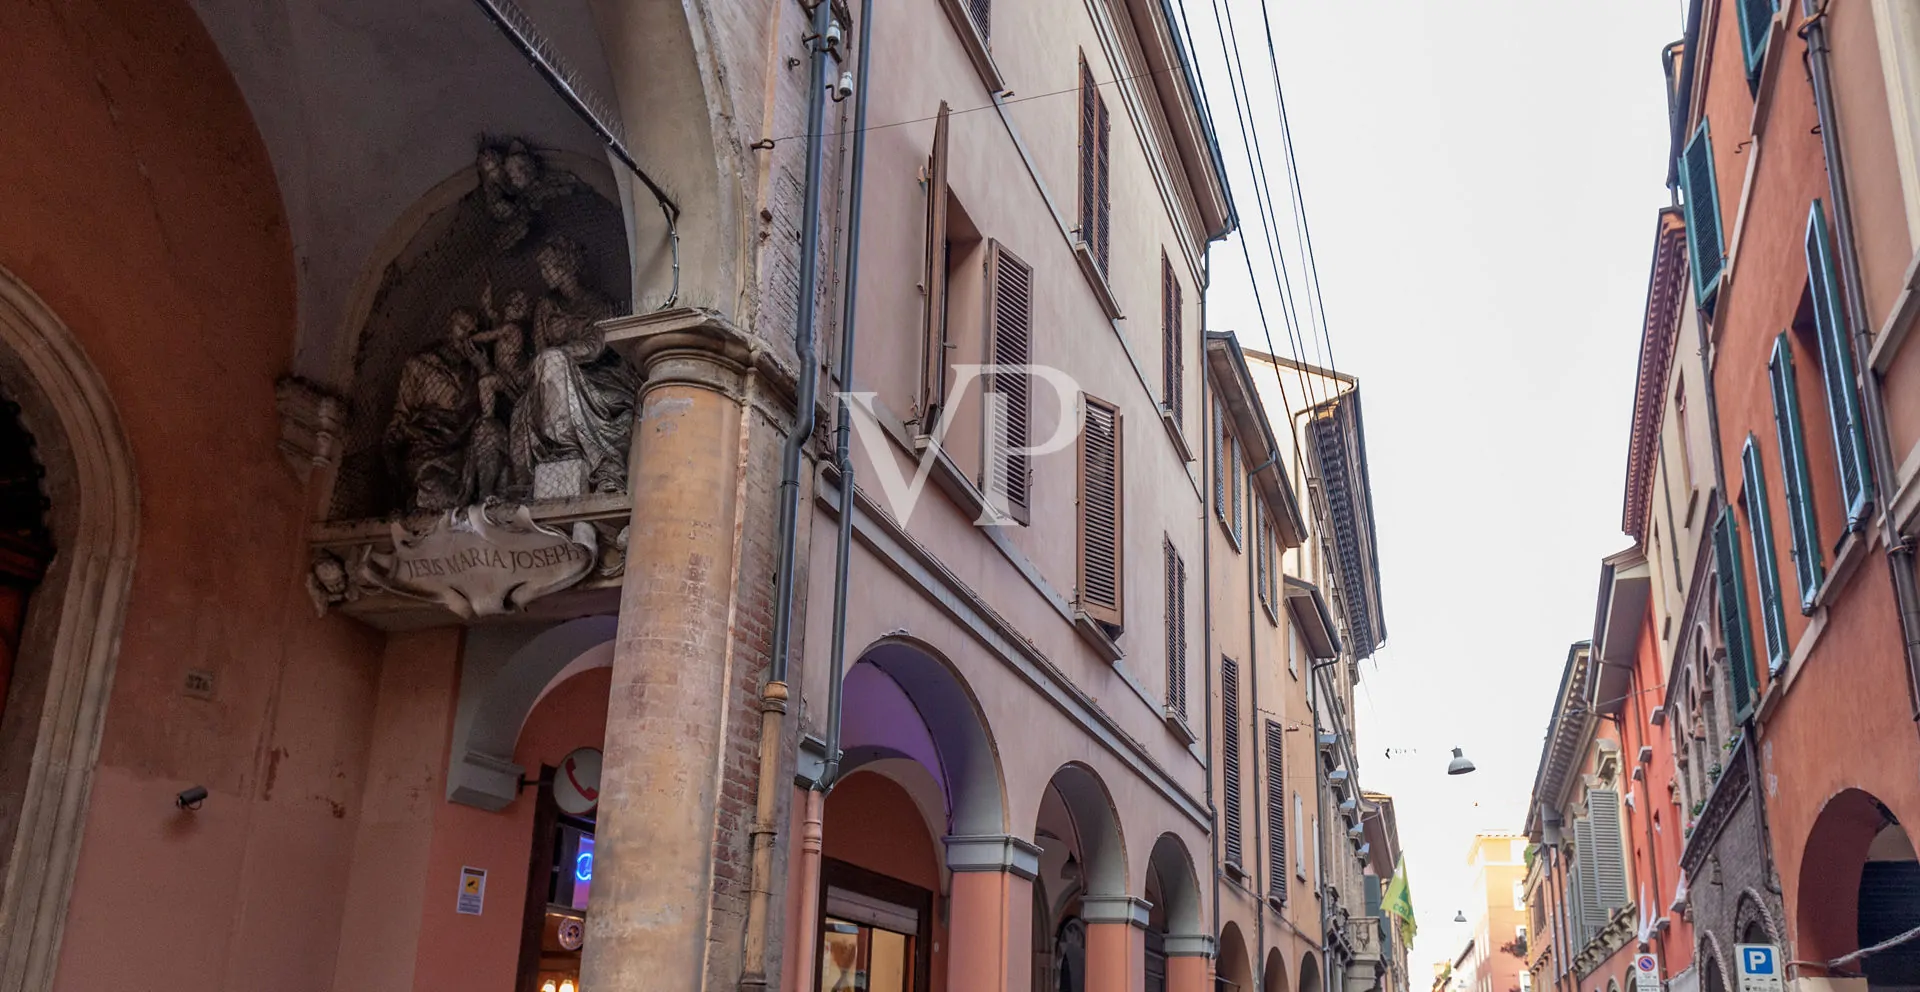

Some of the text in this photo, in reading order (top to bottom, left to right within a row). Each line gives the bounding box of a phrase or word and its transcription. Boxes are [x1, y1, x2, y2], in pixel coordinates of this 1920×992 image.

[403, 543, 581, 582] JESUS MARIA JOSEPH
[1749, 951, 1767, 971] P
